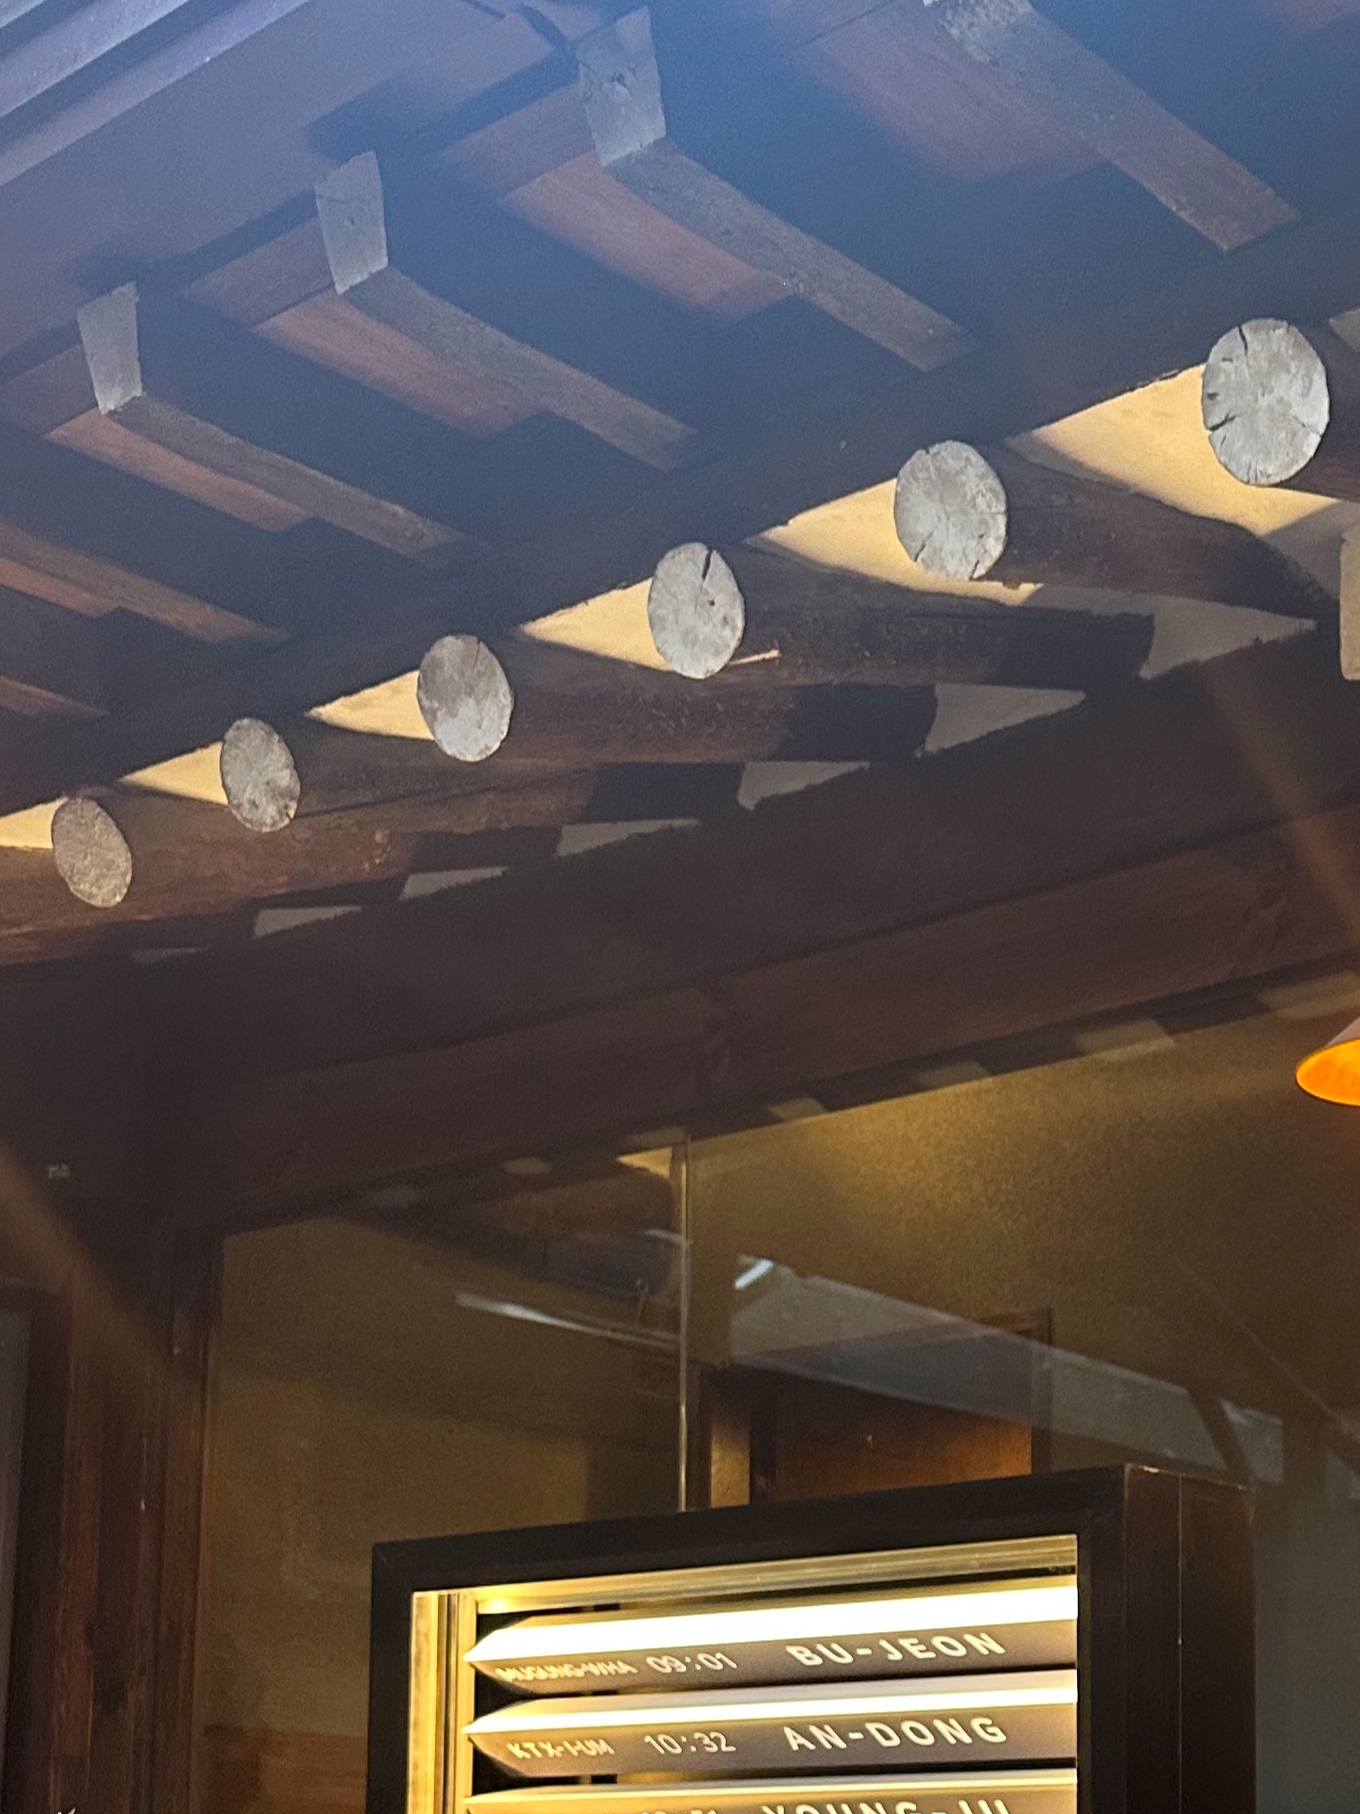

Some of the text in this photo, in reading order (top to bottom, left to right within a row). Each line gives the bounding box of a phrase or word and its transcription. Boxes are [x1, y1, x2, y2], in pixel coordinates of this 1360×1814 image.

[646, 1652, 738, 1674] 09:01
[785, 1632, 1006, 1666] BU-JEON
[644, 1731, 737, 1755] 10:32
[783, 1717, 1007, 1751] AN-DONG
